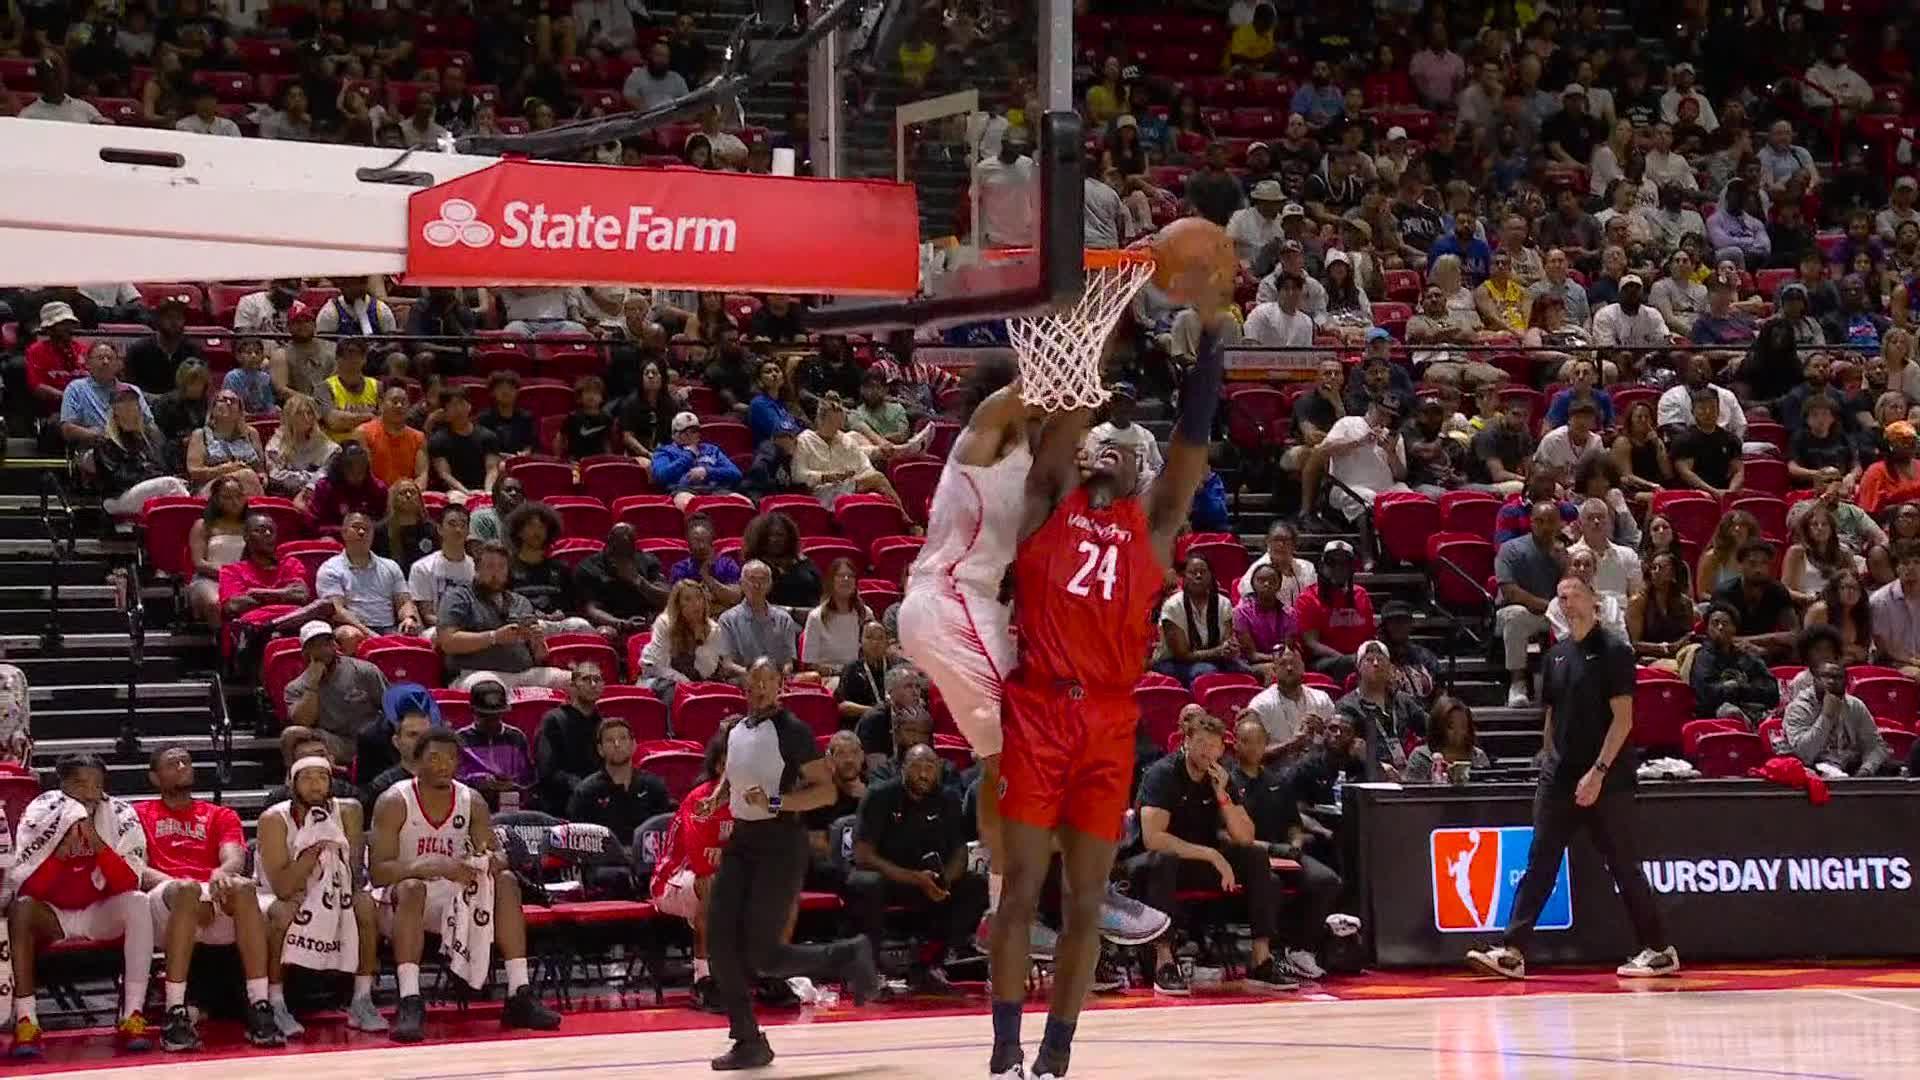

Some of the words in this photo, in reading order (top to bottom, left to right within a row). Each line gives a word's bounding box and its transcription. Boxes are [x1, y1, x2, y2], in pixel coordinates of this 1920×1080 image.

[1066, 540, 1118, 601] 24
[1604, 858, 1781, 893] URSDAY
[1787, 857, 1912, 891] NIGHTS
